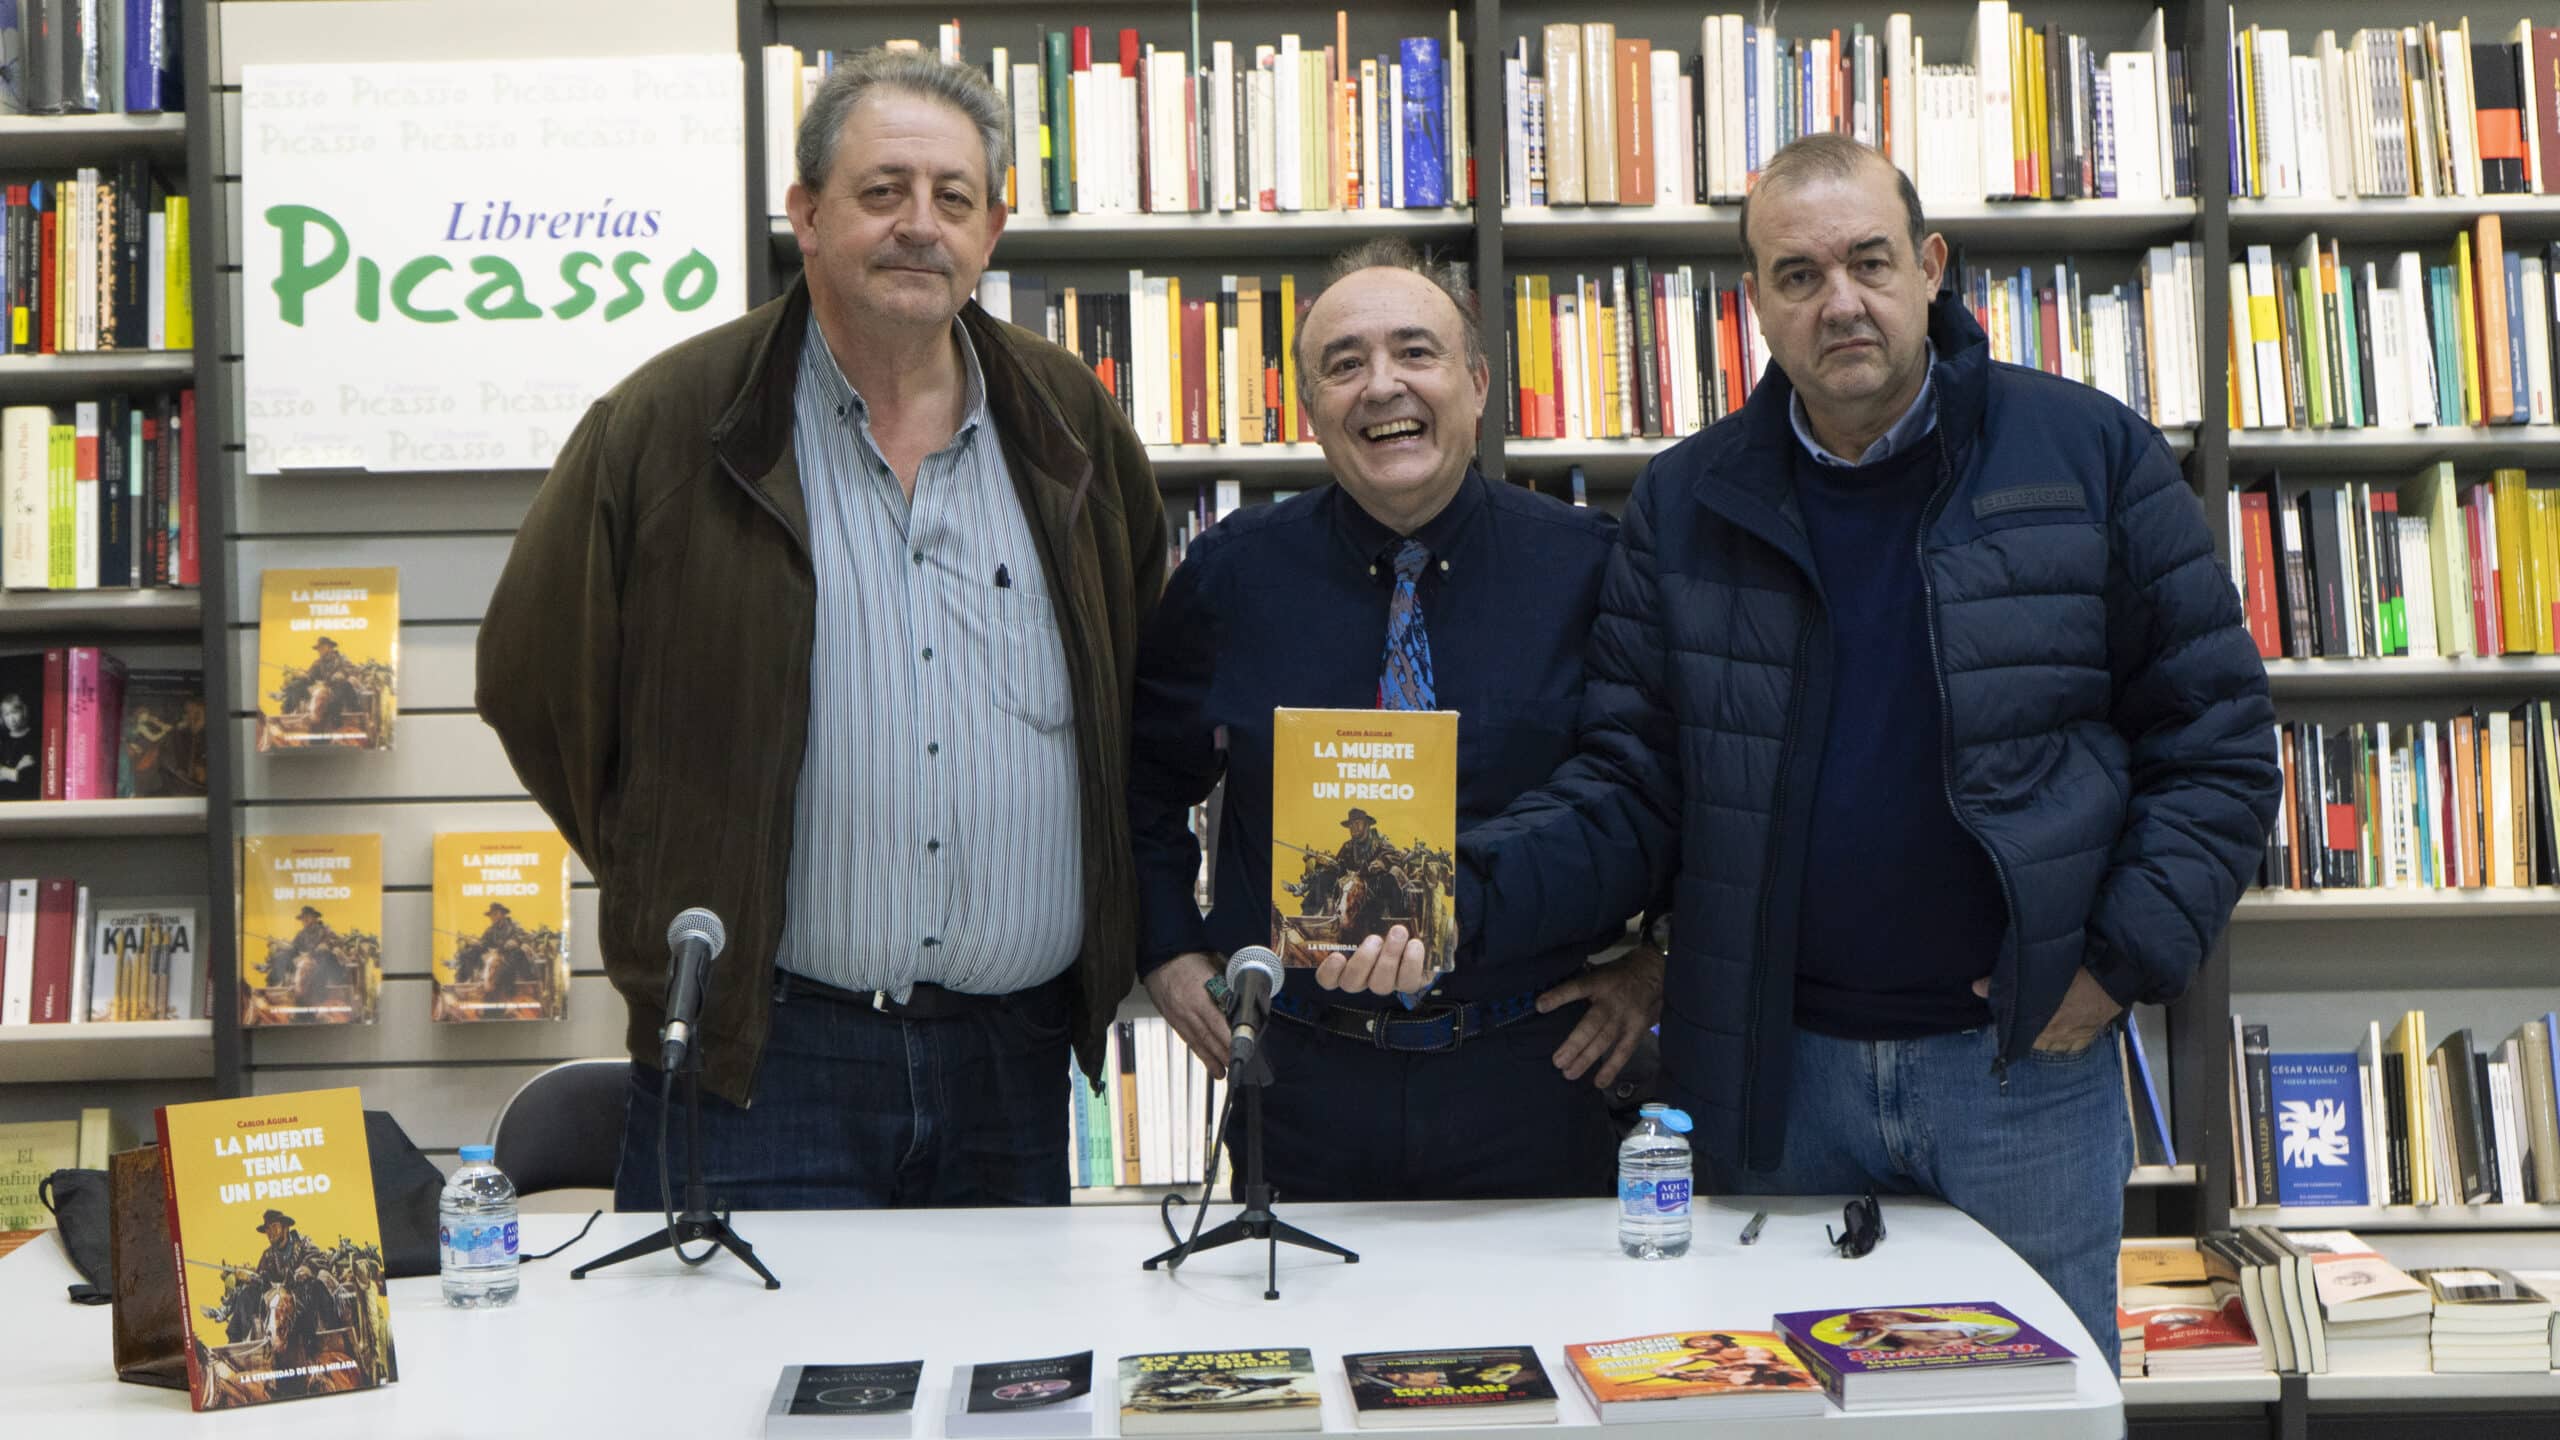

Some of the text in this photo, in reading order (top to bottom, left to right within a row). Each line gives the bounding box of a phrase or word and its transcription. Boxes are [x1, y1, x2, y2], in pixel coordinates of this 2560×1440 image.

[442, 198, 662, 241] Librerías
[264, 204, 718, 327] Picasso
[291, 588, 368, 602] LA MUERTE
[308, 601, 349, 616] TENÍA
[290, 617, 368, 631] UN PRECIO
[1314, 742, 1415, 760] LA MUERTE
[1336, 760, 1392, 780] TENÍA
[1312, 783, 1415, 801] UN PRECIO
[275, 856, 352, 870] LA MUERTE
[463, 853, 539, 867] LA MUERTE
[292, 869, 332, 884] TENÍA
[481, 866, 521, 880] TENÍA
[274, 886, 352, 900] UN PRECIO
[462, 883, 539, 896] UN PRECIO
[103, 925, 190, 955] KAA
[2271, 1064, 2348, 1075] CÉSAR VALLEJO
[214, 1127, 325, 1158] LA MUERTE
[17, 1148, 34, 1164] El
[243, 1152, 304, 1178] TENÍA
[219, 1174, 331, 1205] UN PRECIO
[1660, 1183, 1688, 1192] AQUA
[240, 1374, 251, 1385] LA
[252, 1368, 295, 1383] ETERNIDAD
[296, 1367, 308, 1377] DE
